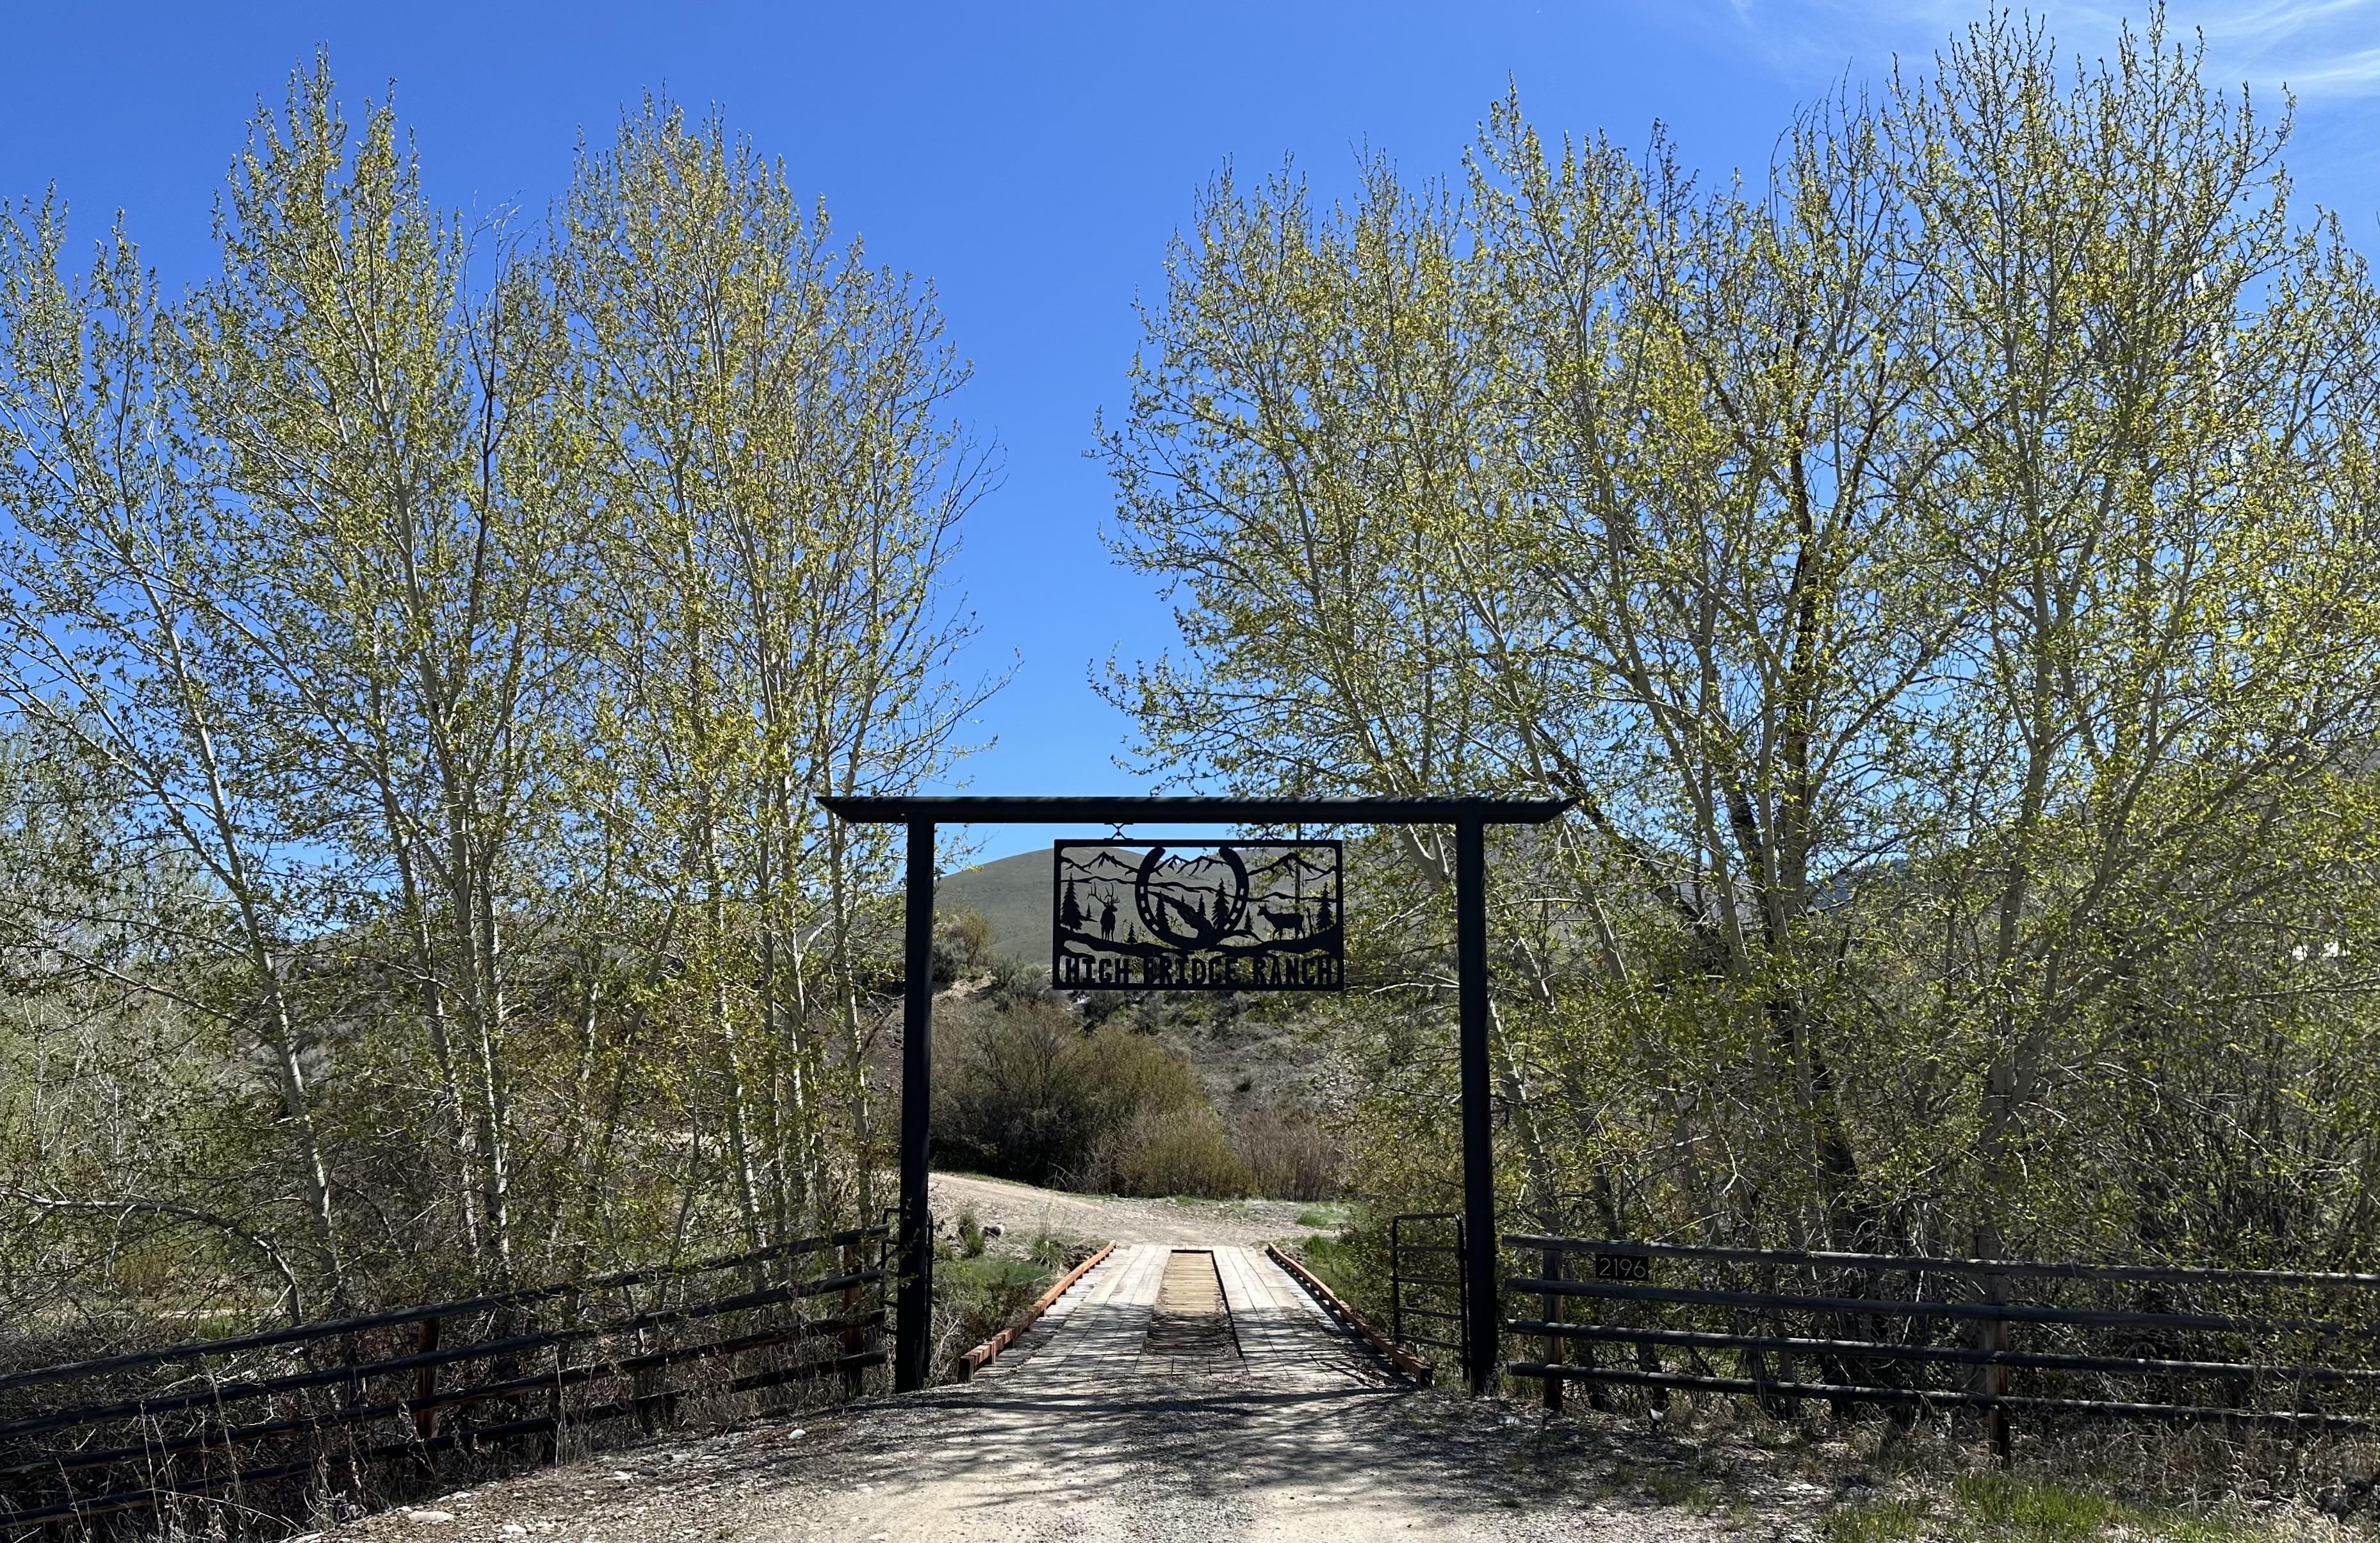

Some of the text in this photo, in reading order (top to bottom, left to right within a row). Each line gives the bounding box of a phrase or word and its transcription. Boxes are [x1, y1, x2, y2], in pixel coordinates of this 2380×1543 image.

[1065, 958, 1332, 985] HIGH BRIDGE RANCH
[1599, 1257, 1646, 1278] 2196
